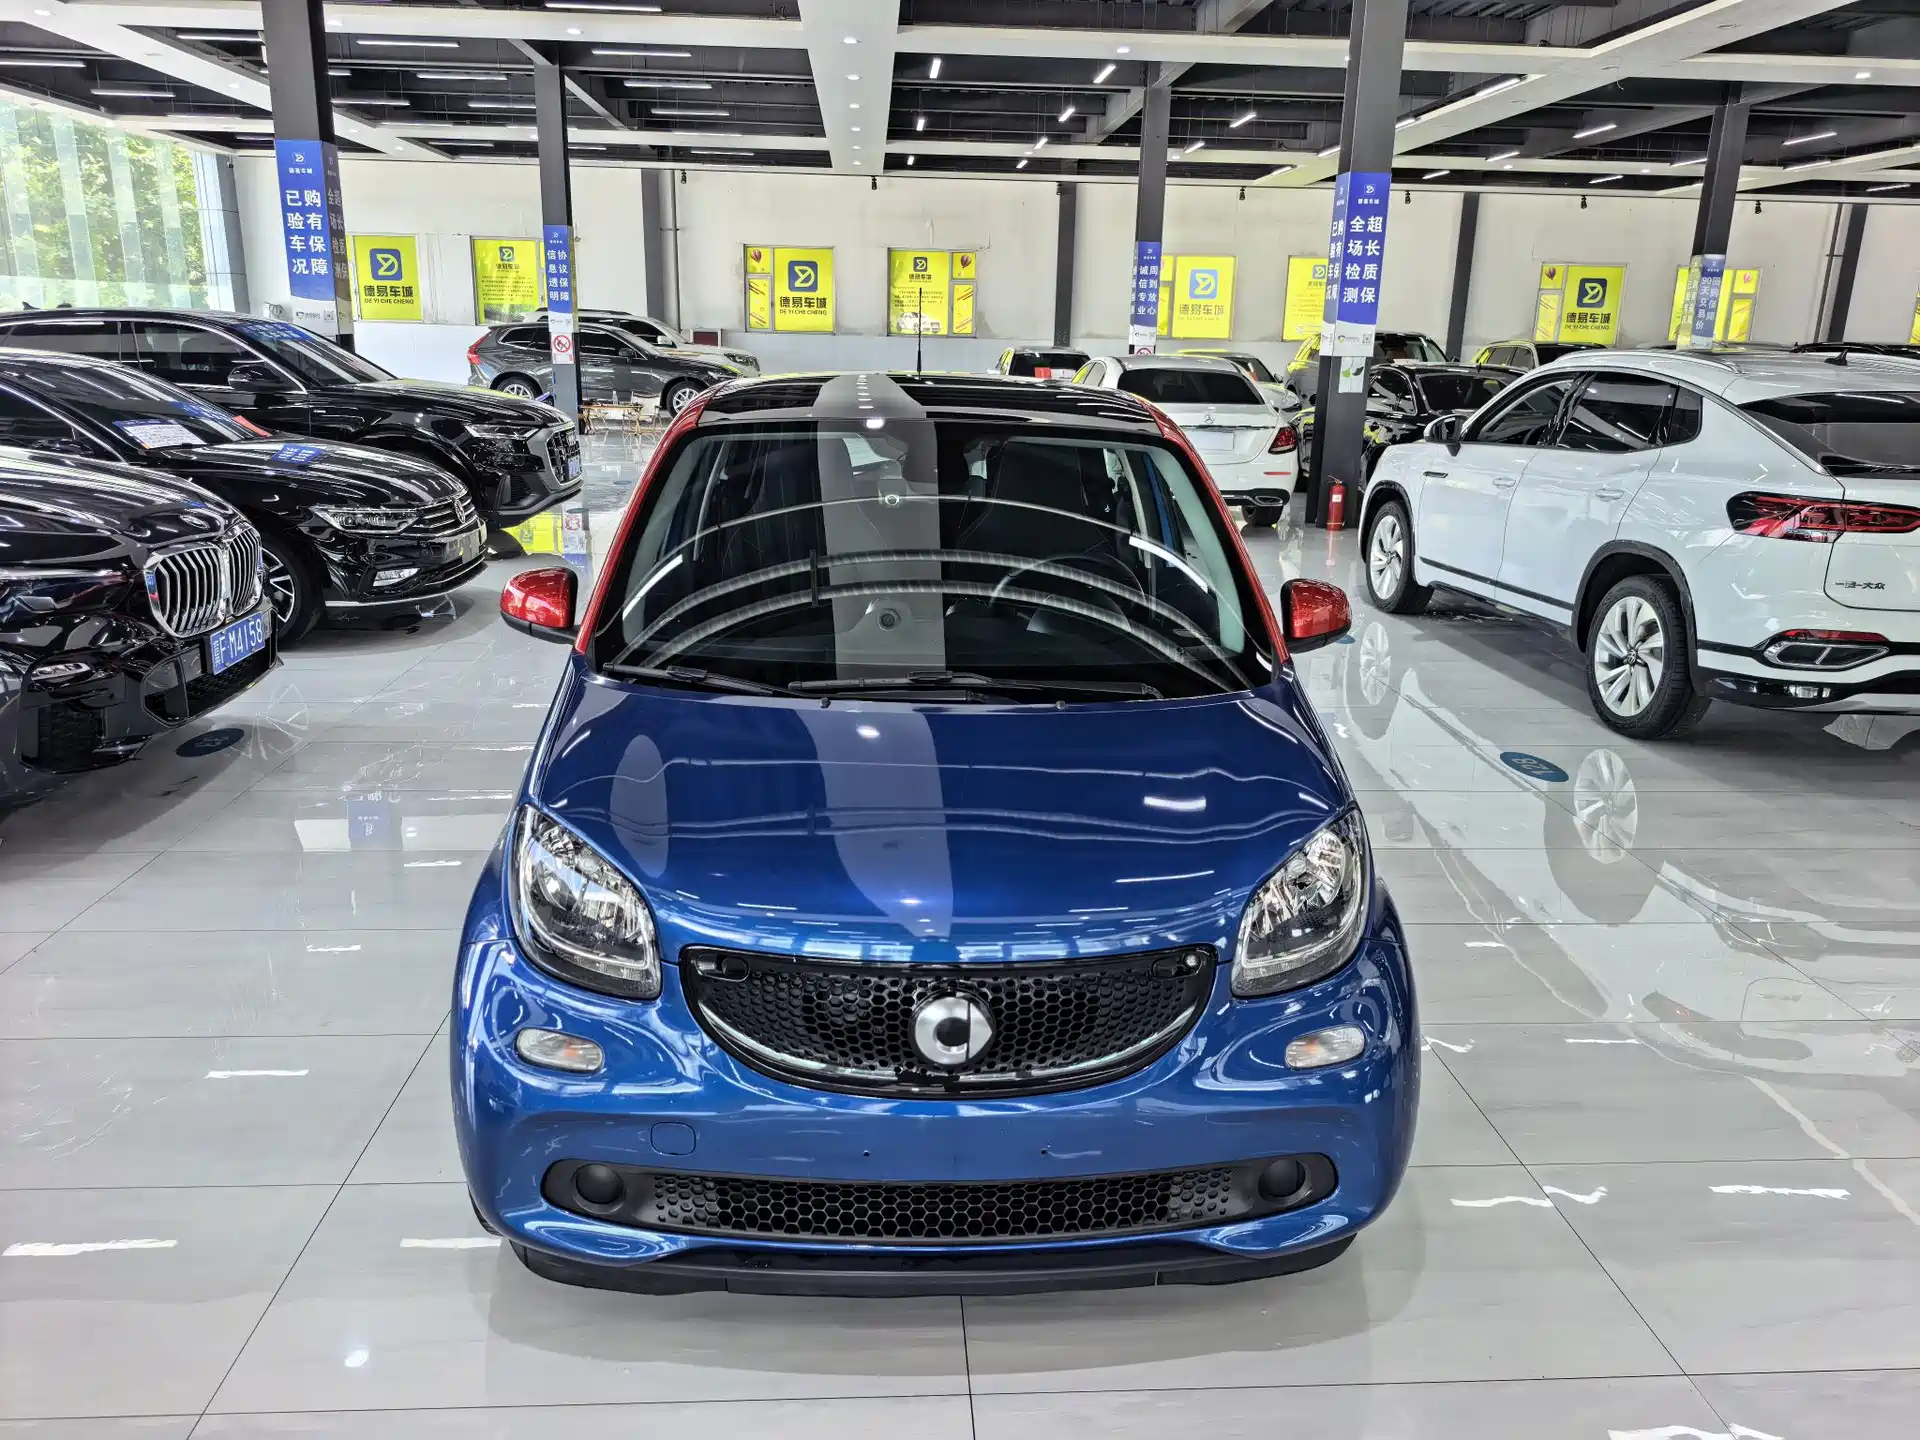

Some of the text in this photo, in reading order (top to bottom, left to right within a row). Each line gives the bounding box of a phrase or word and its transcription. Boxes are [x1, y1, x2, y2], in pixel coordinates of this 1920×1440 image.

[286, 189, 309, 276] 已验车况
[304, 189, 328, 276] 购有保障
[1343, 215, 1366, 304] 全场检测
[1360, 215, 1383, 304] 超长质保
[364, 285, 414, 298] 德易车城
[779, 296, 827, 309] 德易车城
[1566, 312, 1612, 324] 德易车城
